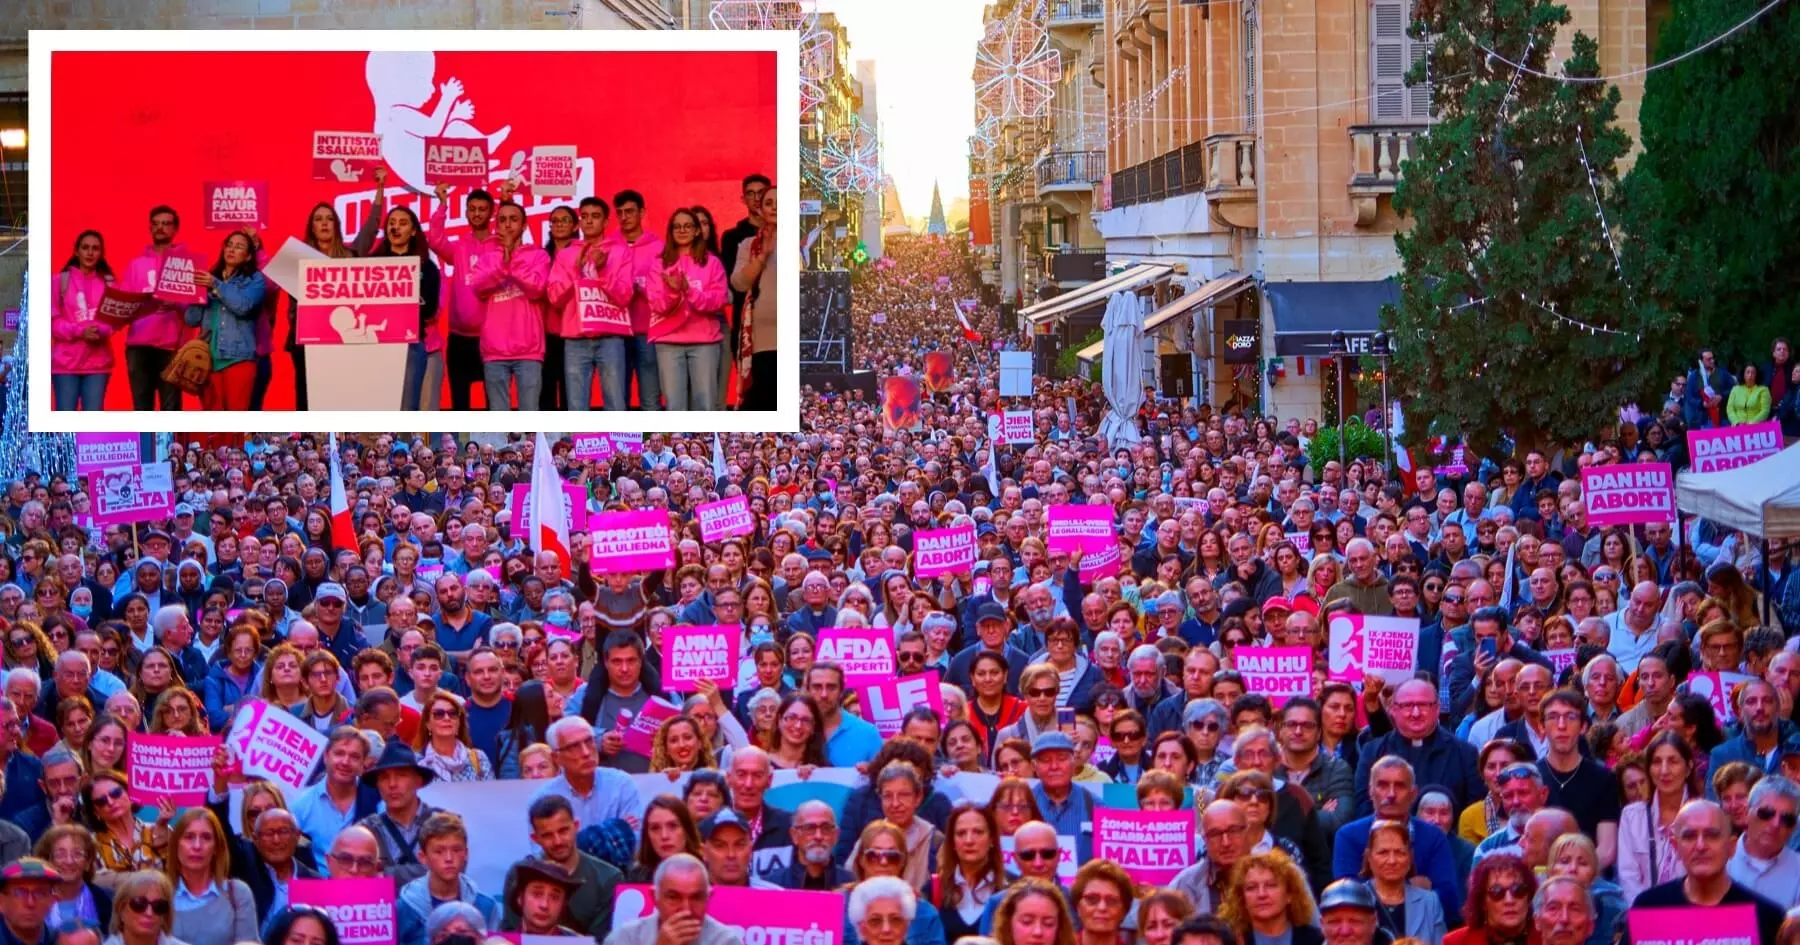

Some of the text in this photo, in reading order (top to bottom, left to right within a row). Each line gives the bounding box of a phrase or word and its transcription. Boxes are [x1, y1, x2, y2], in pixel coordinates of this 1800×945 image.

[317, 135, 341, 146] INTI
[317, 145, 379, 156] SSALVANI
[427, 145, 485, 162] AFDA
[535, 169, 572, 178] JIENA
[212, 200, 256, 211] FAVUR
[306, 265, 416, 282] INTI TISTA'
[305, 282, 413, 298] SSALVANI
[584, 304, 628, 323] ABORT
[1006, 416, 1031, 425] JIEN
[576, 437, 609, 448] AFDA
[1695, 431, 1777, 456] DAN HU
[1587, 471, 1666, 490] DAN HU
[1591, 491, 1667, 510] ABORT
[700, 501, 746, 521] DAN HU
[705, 513, 748, 533] ABORT
[596, 540, 667, 554] LIL ULIEDNA
[917, 531, 971, 551] DAN HU
[920, 547, 971, 566] ABORT
[817, 637, 892, 659] AFDA
[1403, 640, 1414, 649] LI
[672, 650, 729, 667] FAVUR
[1368, 648, 1412, 661] JIENA
[1237, 655, 1307, 673] DAN HU
[1367, 660, 1412, 670] BNIEDEM
[262, 717, 318, 760] JIEN
[164, 745, 215, 757] L-ABORT
[140, 754, 182, 767] BARRA
[249, 748, 305, 789] VUĊI
[134, 769, 209, 789] MALTA
[1136, 820, 1188, 831] L-ABORT
[1112, 832, 1154, 843] BARRA
[1105, 846, 1184, 867] MALTA
